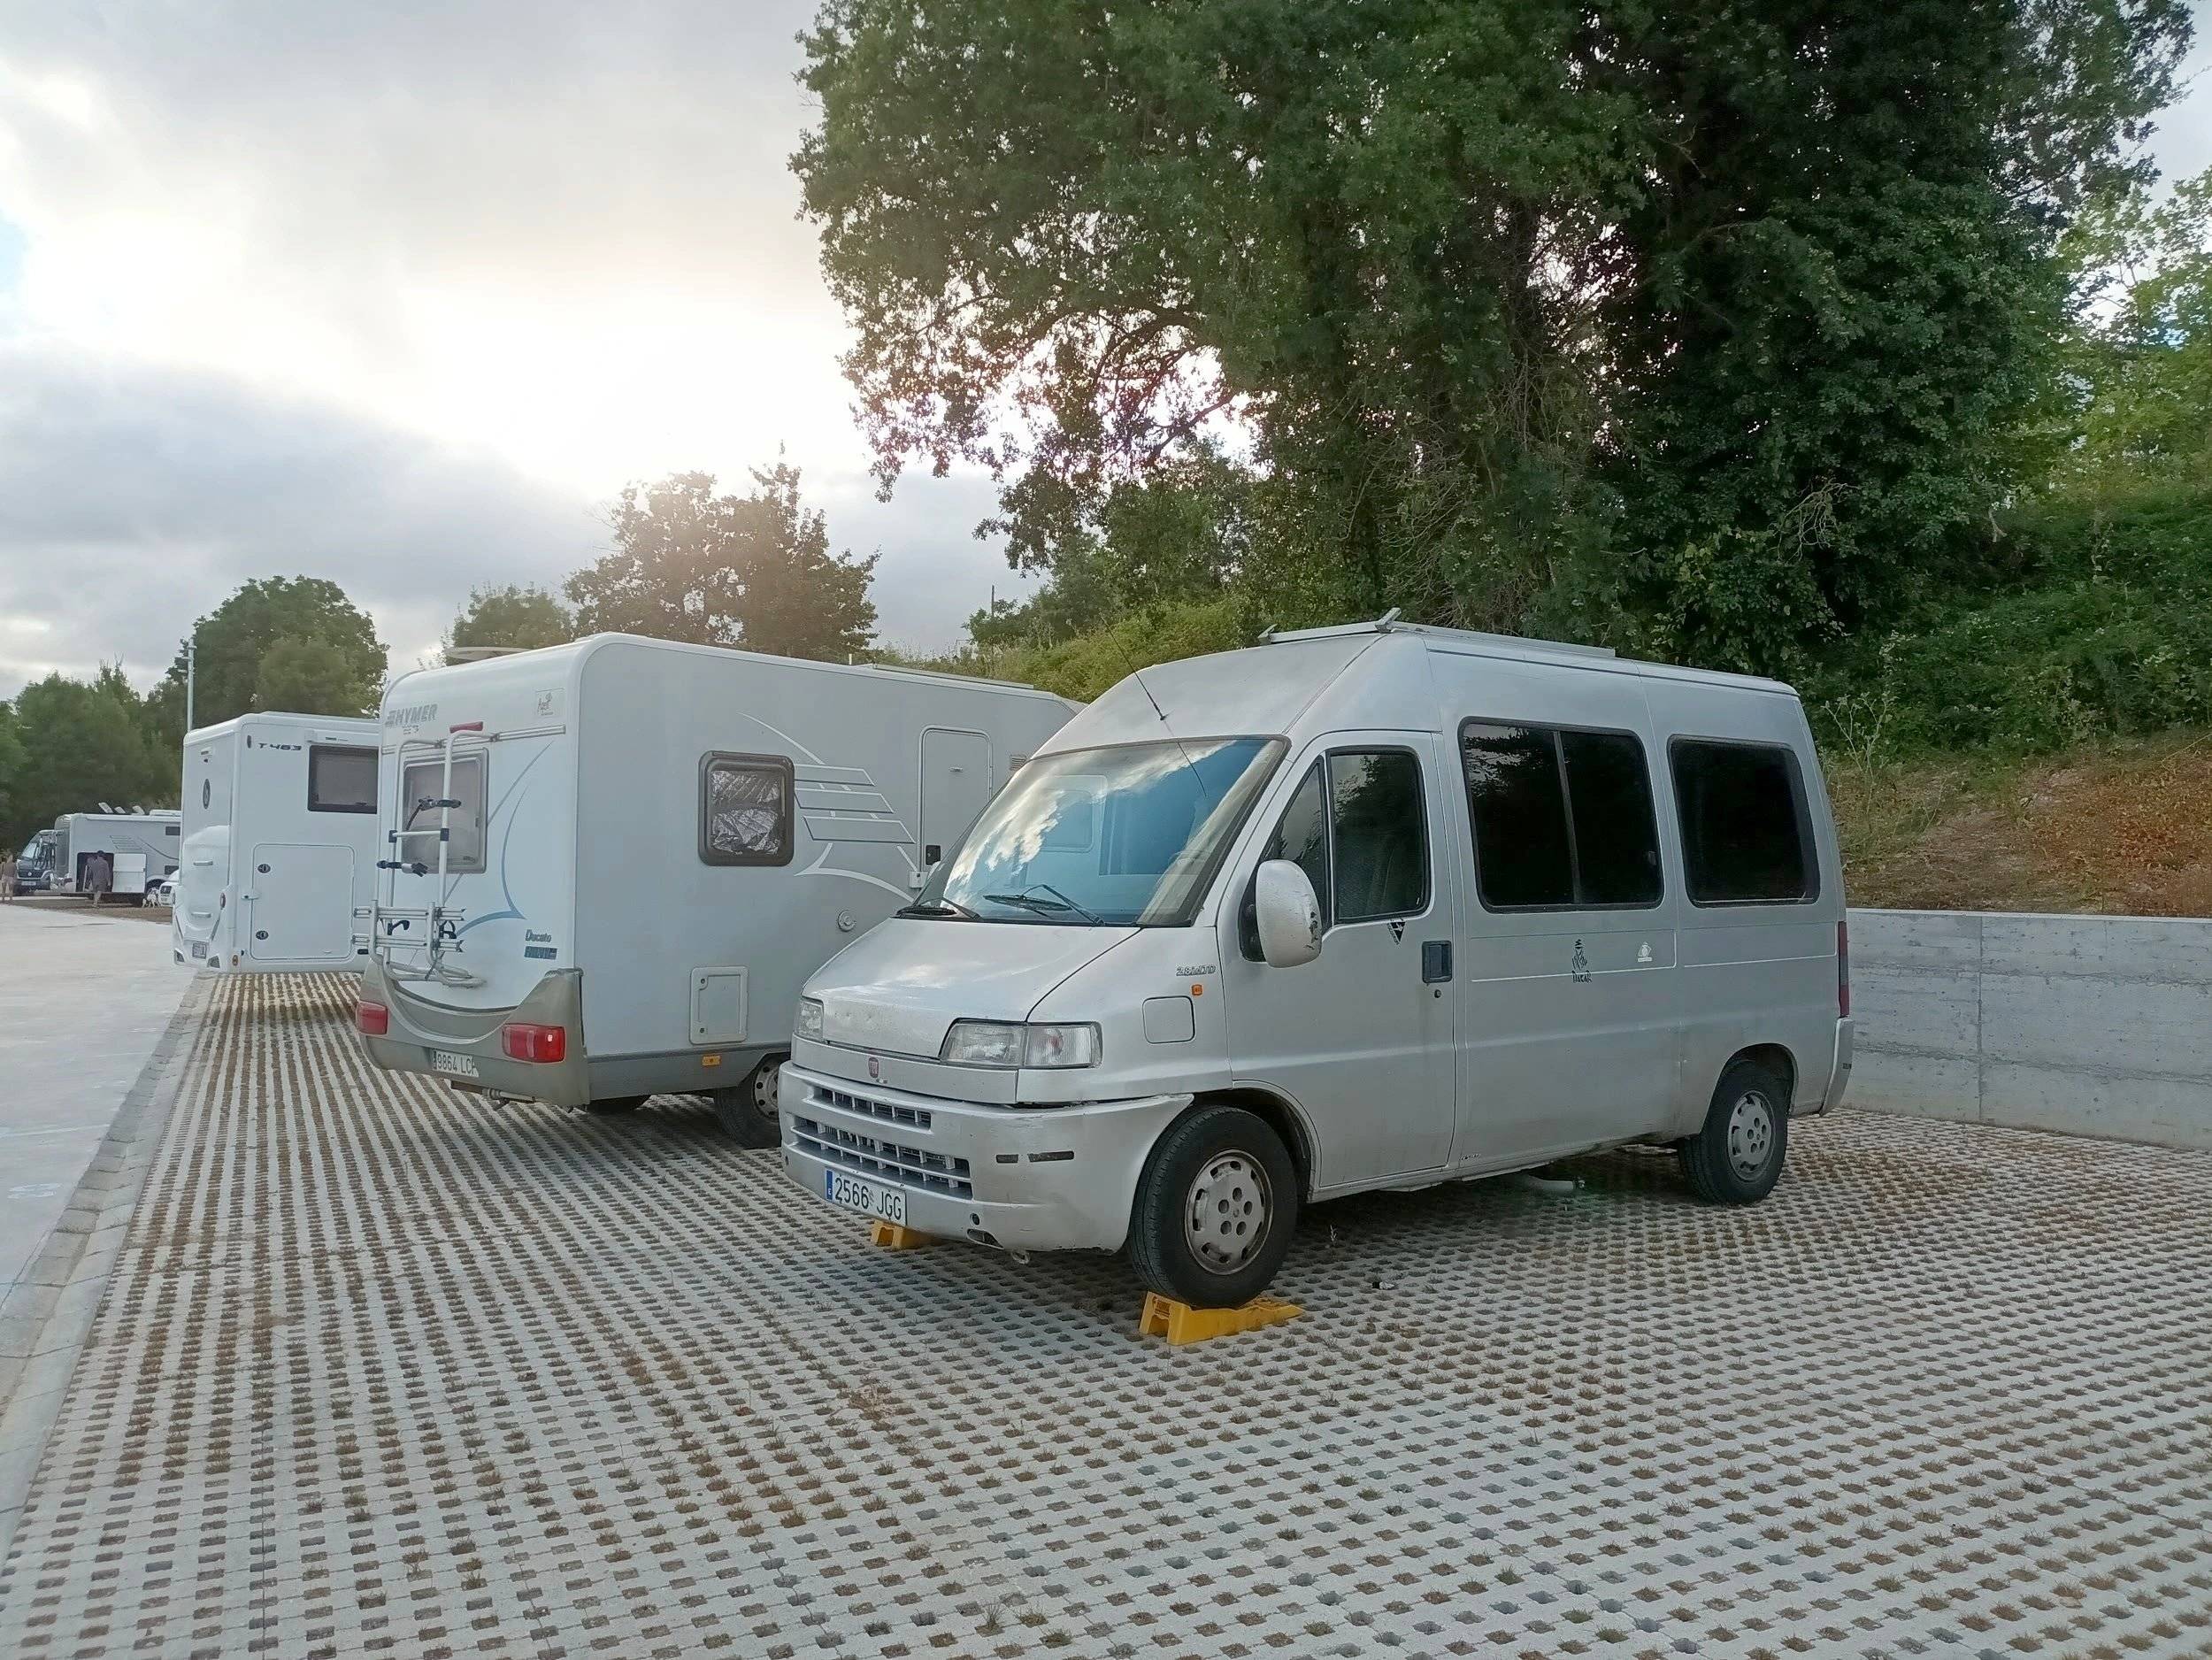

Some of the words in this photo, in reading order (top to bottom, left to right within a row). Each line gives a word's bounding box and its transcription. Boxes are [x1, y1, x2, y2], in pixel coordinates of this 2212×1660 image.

[395, 703, 439, 726] HYMER
[526, 928, 552, 943] Ducato
[437, 1053, 458, 1072] 9864
[834, 1177, 870, 1210] 2566
[876, 1190, 902, 1221] JGG
